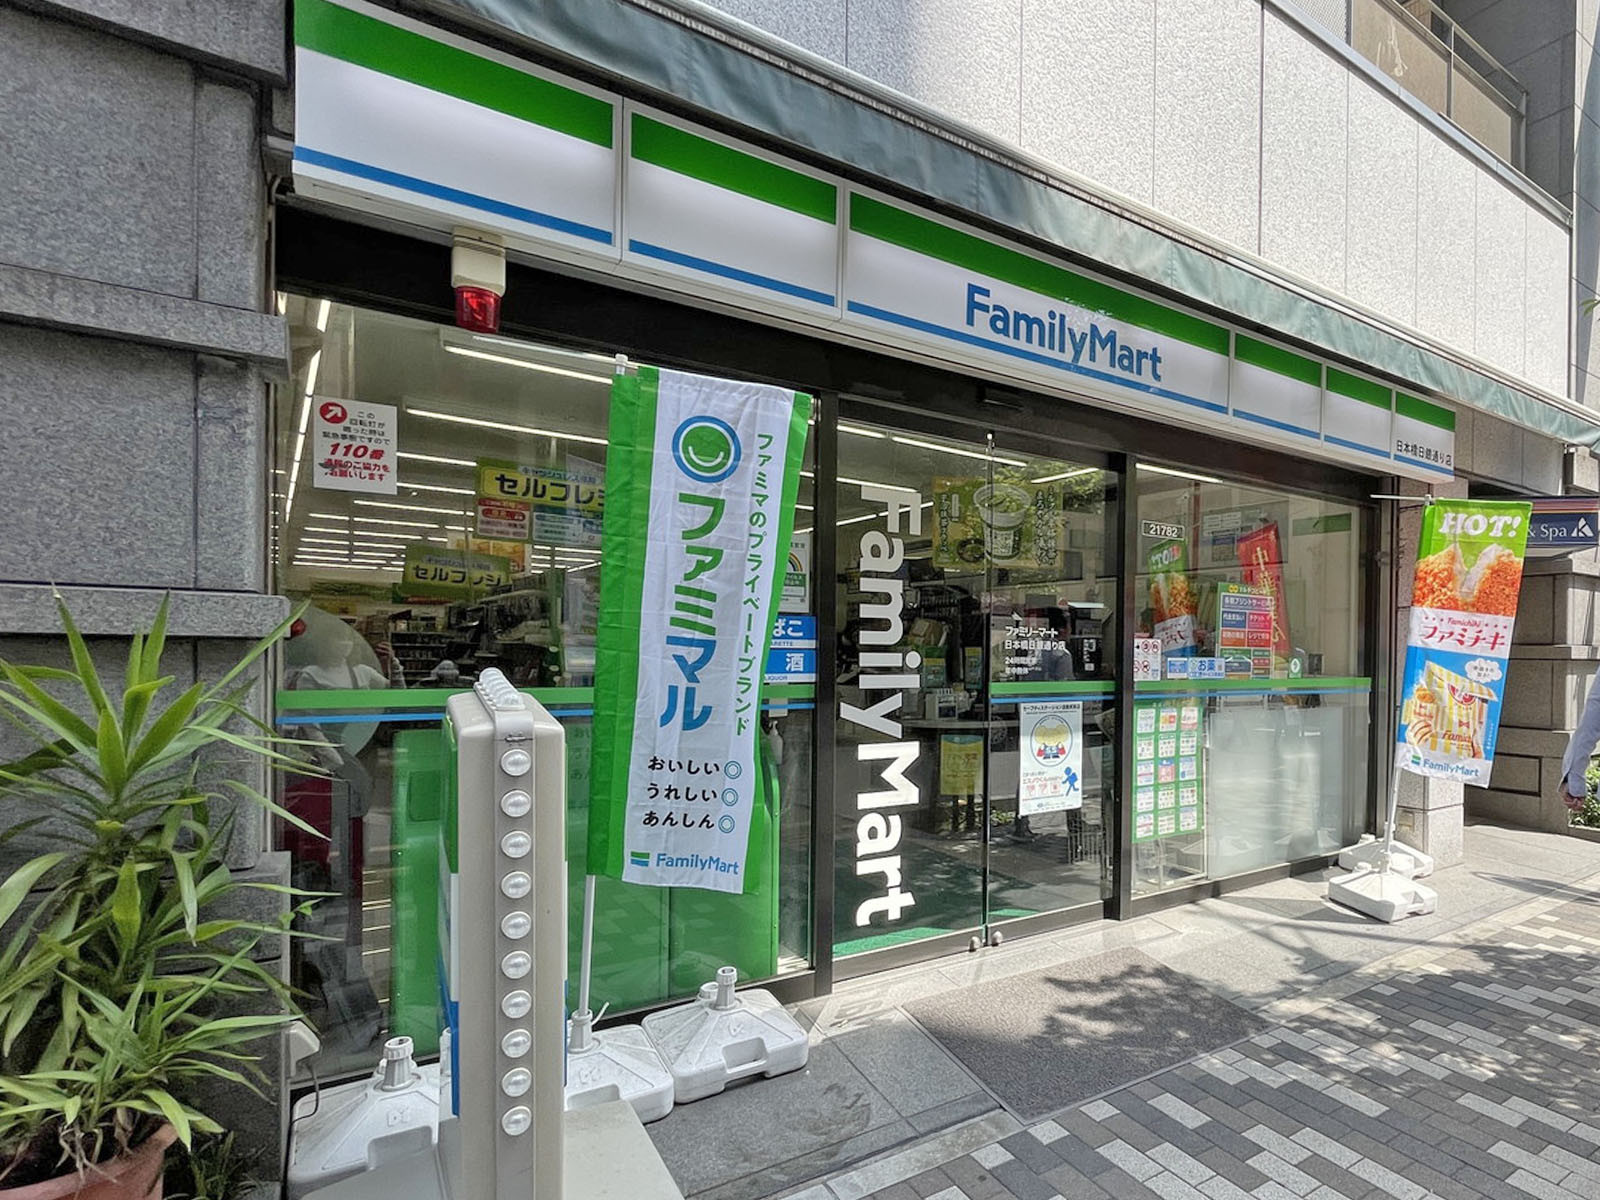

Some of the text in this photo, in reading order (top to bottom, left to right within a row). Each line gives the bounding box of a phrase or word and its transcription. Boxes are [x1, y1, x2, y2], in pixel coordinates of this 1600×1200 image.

[966, 283, 1163, 382] FamilyMart
[358, 411, 376, 419] この
[330, 442, 385, 460] 110番
[1149, 523, 1179, 538] 21782
[1439, 512, 1522, 537] HOT!
[1540, 523, 1568, 541] Spa
[735, 434, 774, 737] ファミマのプライベートブランド
[659, 492, 726, 732] ファミマル
[1004, 626, 1059, 638] ファミリーマート
[1419, 625, 1506, 651] ファミチキ
[786, 652, 805, 672] 酒
[840, 484, 922, 927] FamilyMart
[647, 756, 720, 775] おいしい
[1423, 758, 1480, 777] FamilyMart
[647, 783, 717, 802] うれしい
[643, 811, 715, 829] あんしん
[656, 853, 740, 876] FamilyMart
